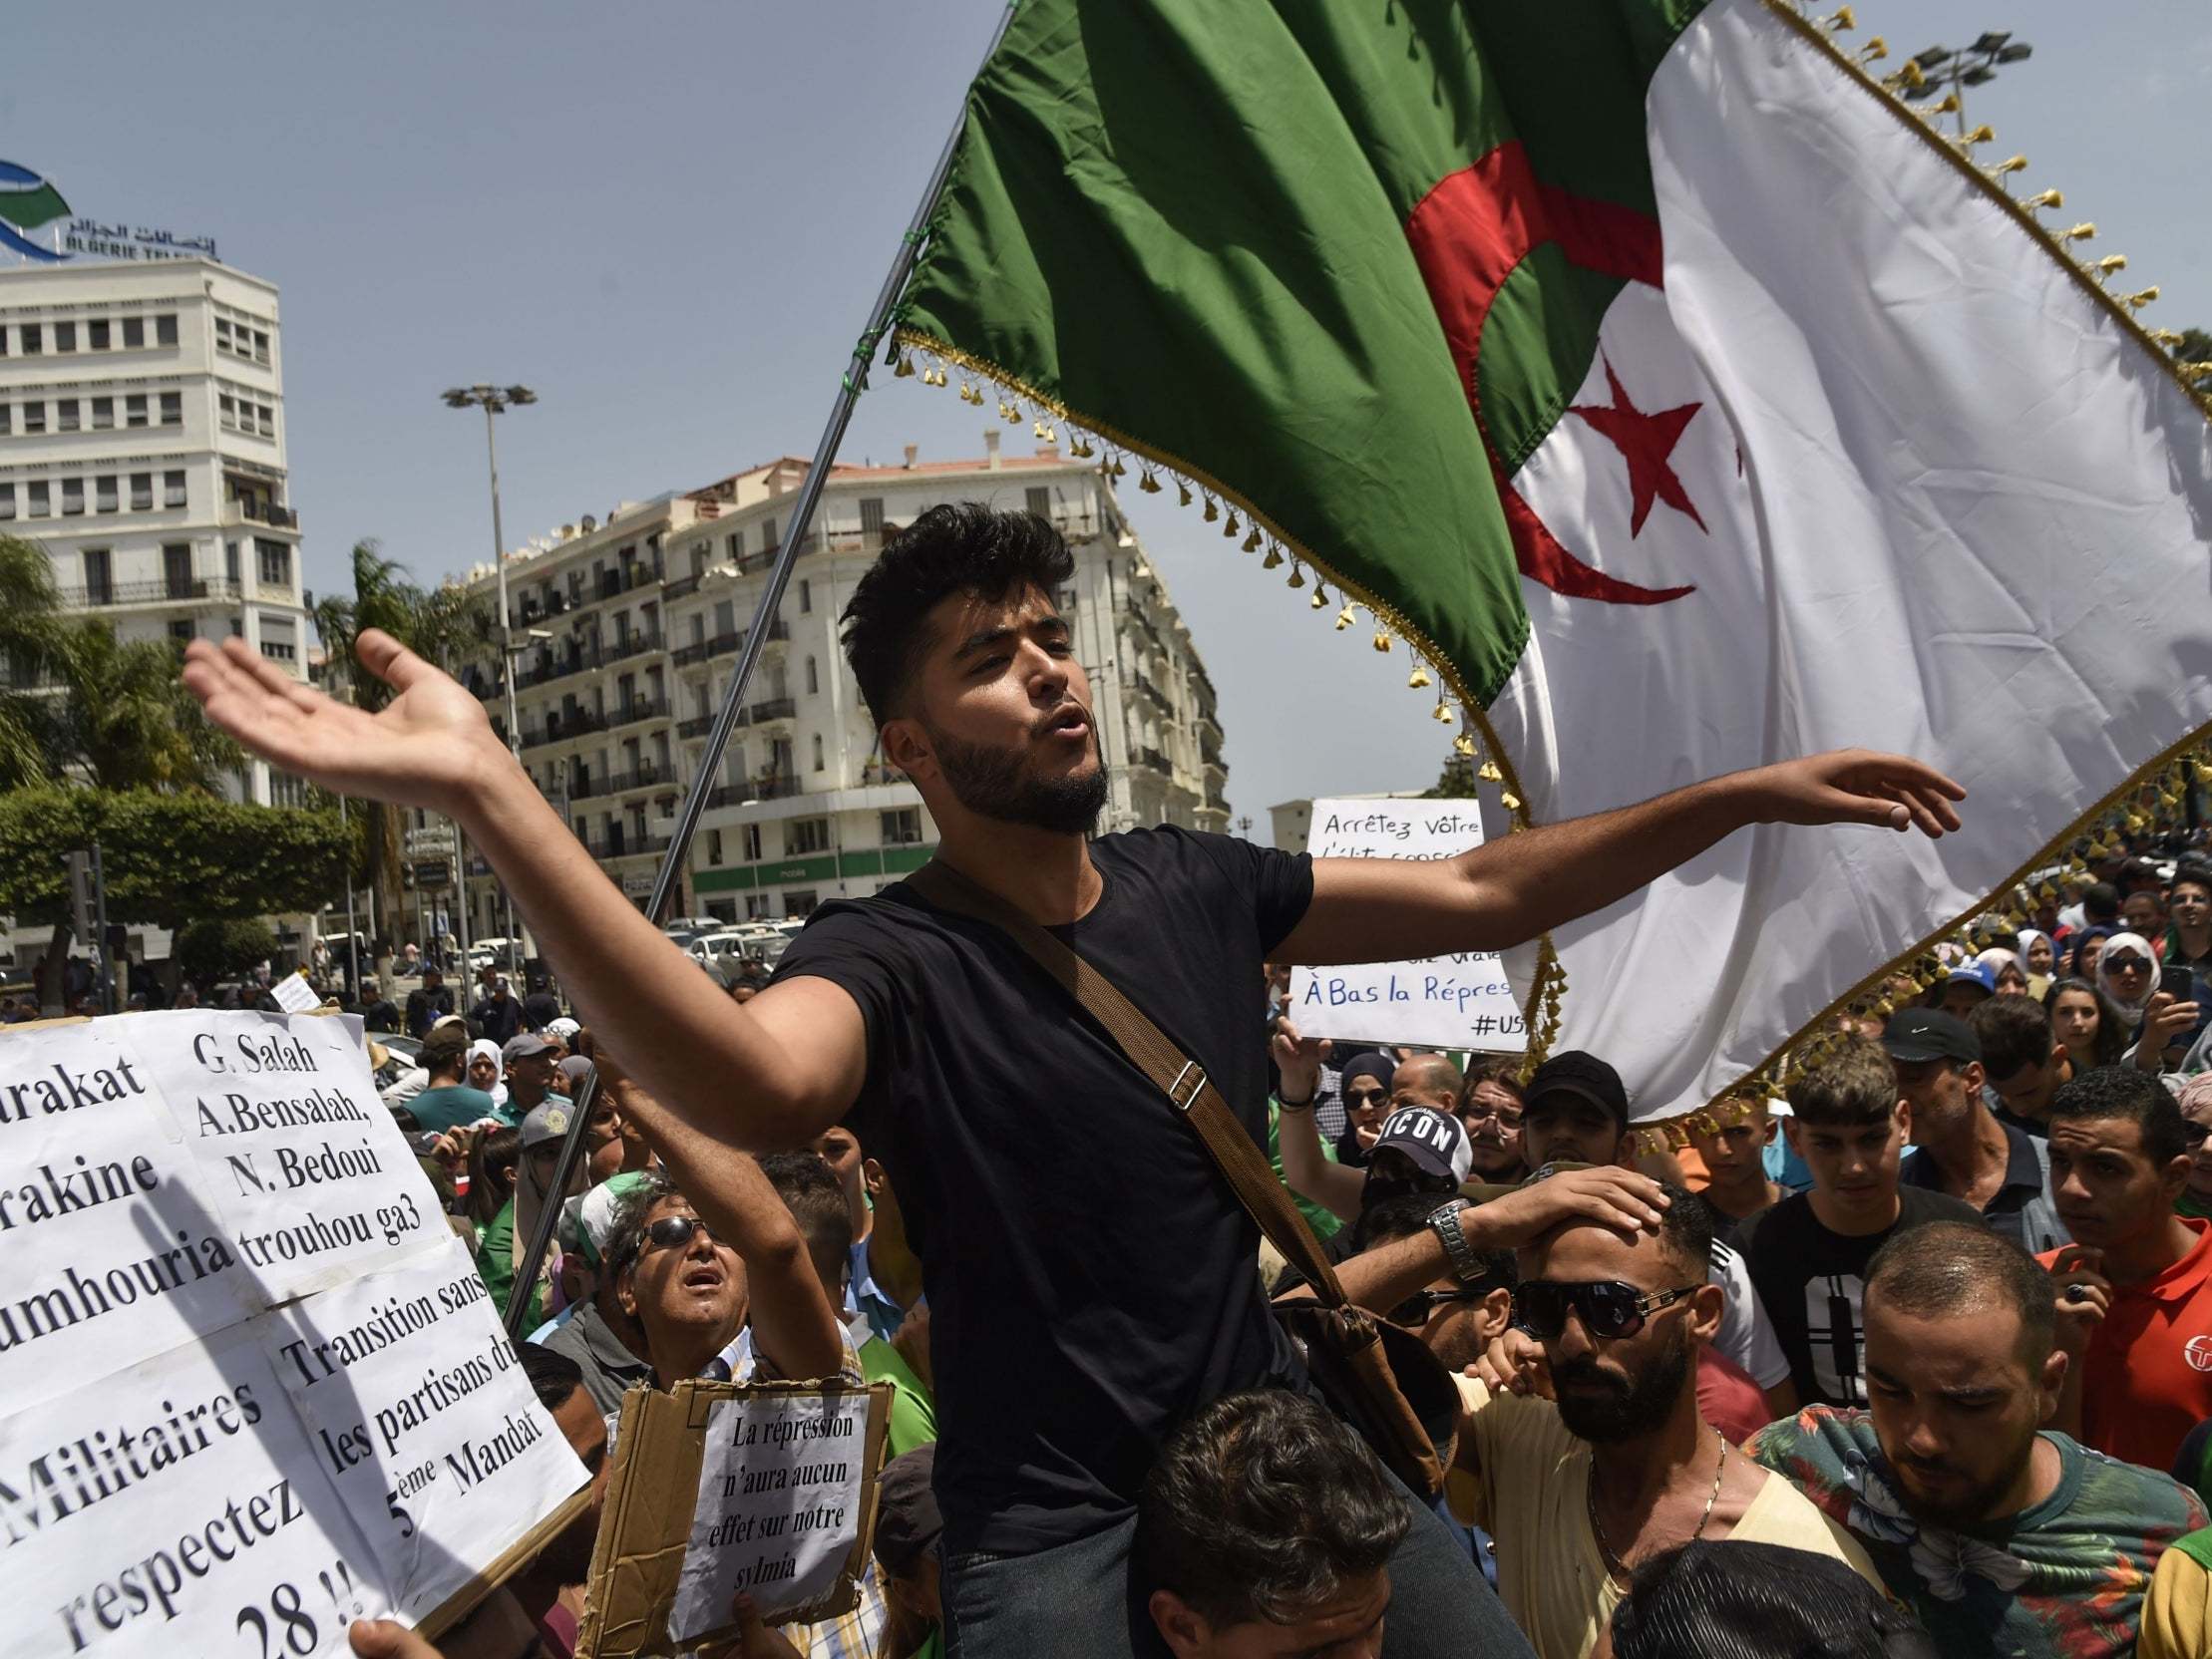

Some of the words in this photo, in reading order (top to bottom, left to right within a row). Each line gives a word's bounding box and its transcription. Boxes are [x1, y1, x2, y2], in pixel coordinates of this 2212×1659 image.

[66, 234, 137, 260] ALGERIE
[1324, 813, 1411, 839] Arrêtez
[1389, 975, 1410, 1002] la
[193, 1033, 237, 1074] G.
[236, 1033, 319, 1074] Salah
[1383, 1112, 1453, 1153] ICON
[224, 1153, 276, 1197] N.
[273, 1138, 384, 1189] Bedoui
[238, 1212, 374, 1268] trouhou
[376, 1192, 422, 1246] ga3
[279, 1296, 439, 1388] Transition
[437, 1271, 489, 1315] sans
[319, 1422, 373, 1476] les
[375, 1354, 494, 1459] partisans
[490, 1334, 522, 1373] du
[732, 1417, 757, 1447] La
[763, 1411, 853, 1451] répression
[0, 1383, 261, 1546] Militaires
[443, 1402, 544, 1497] Mandat
[791, 1462, 847, 1486] aucun
[709, 1512, 757, 1548] effet
[757, 1511, 790, 1540] sur
[793, 1502, 845, 1533] notre
[55, 1479, 304, 1655] respectez
[235, 1583, 319, 1659] 28
